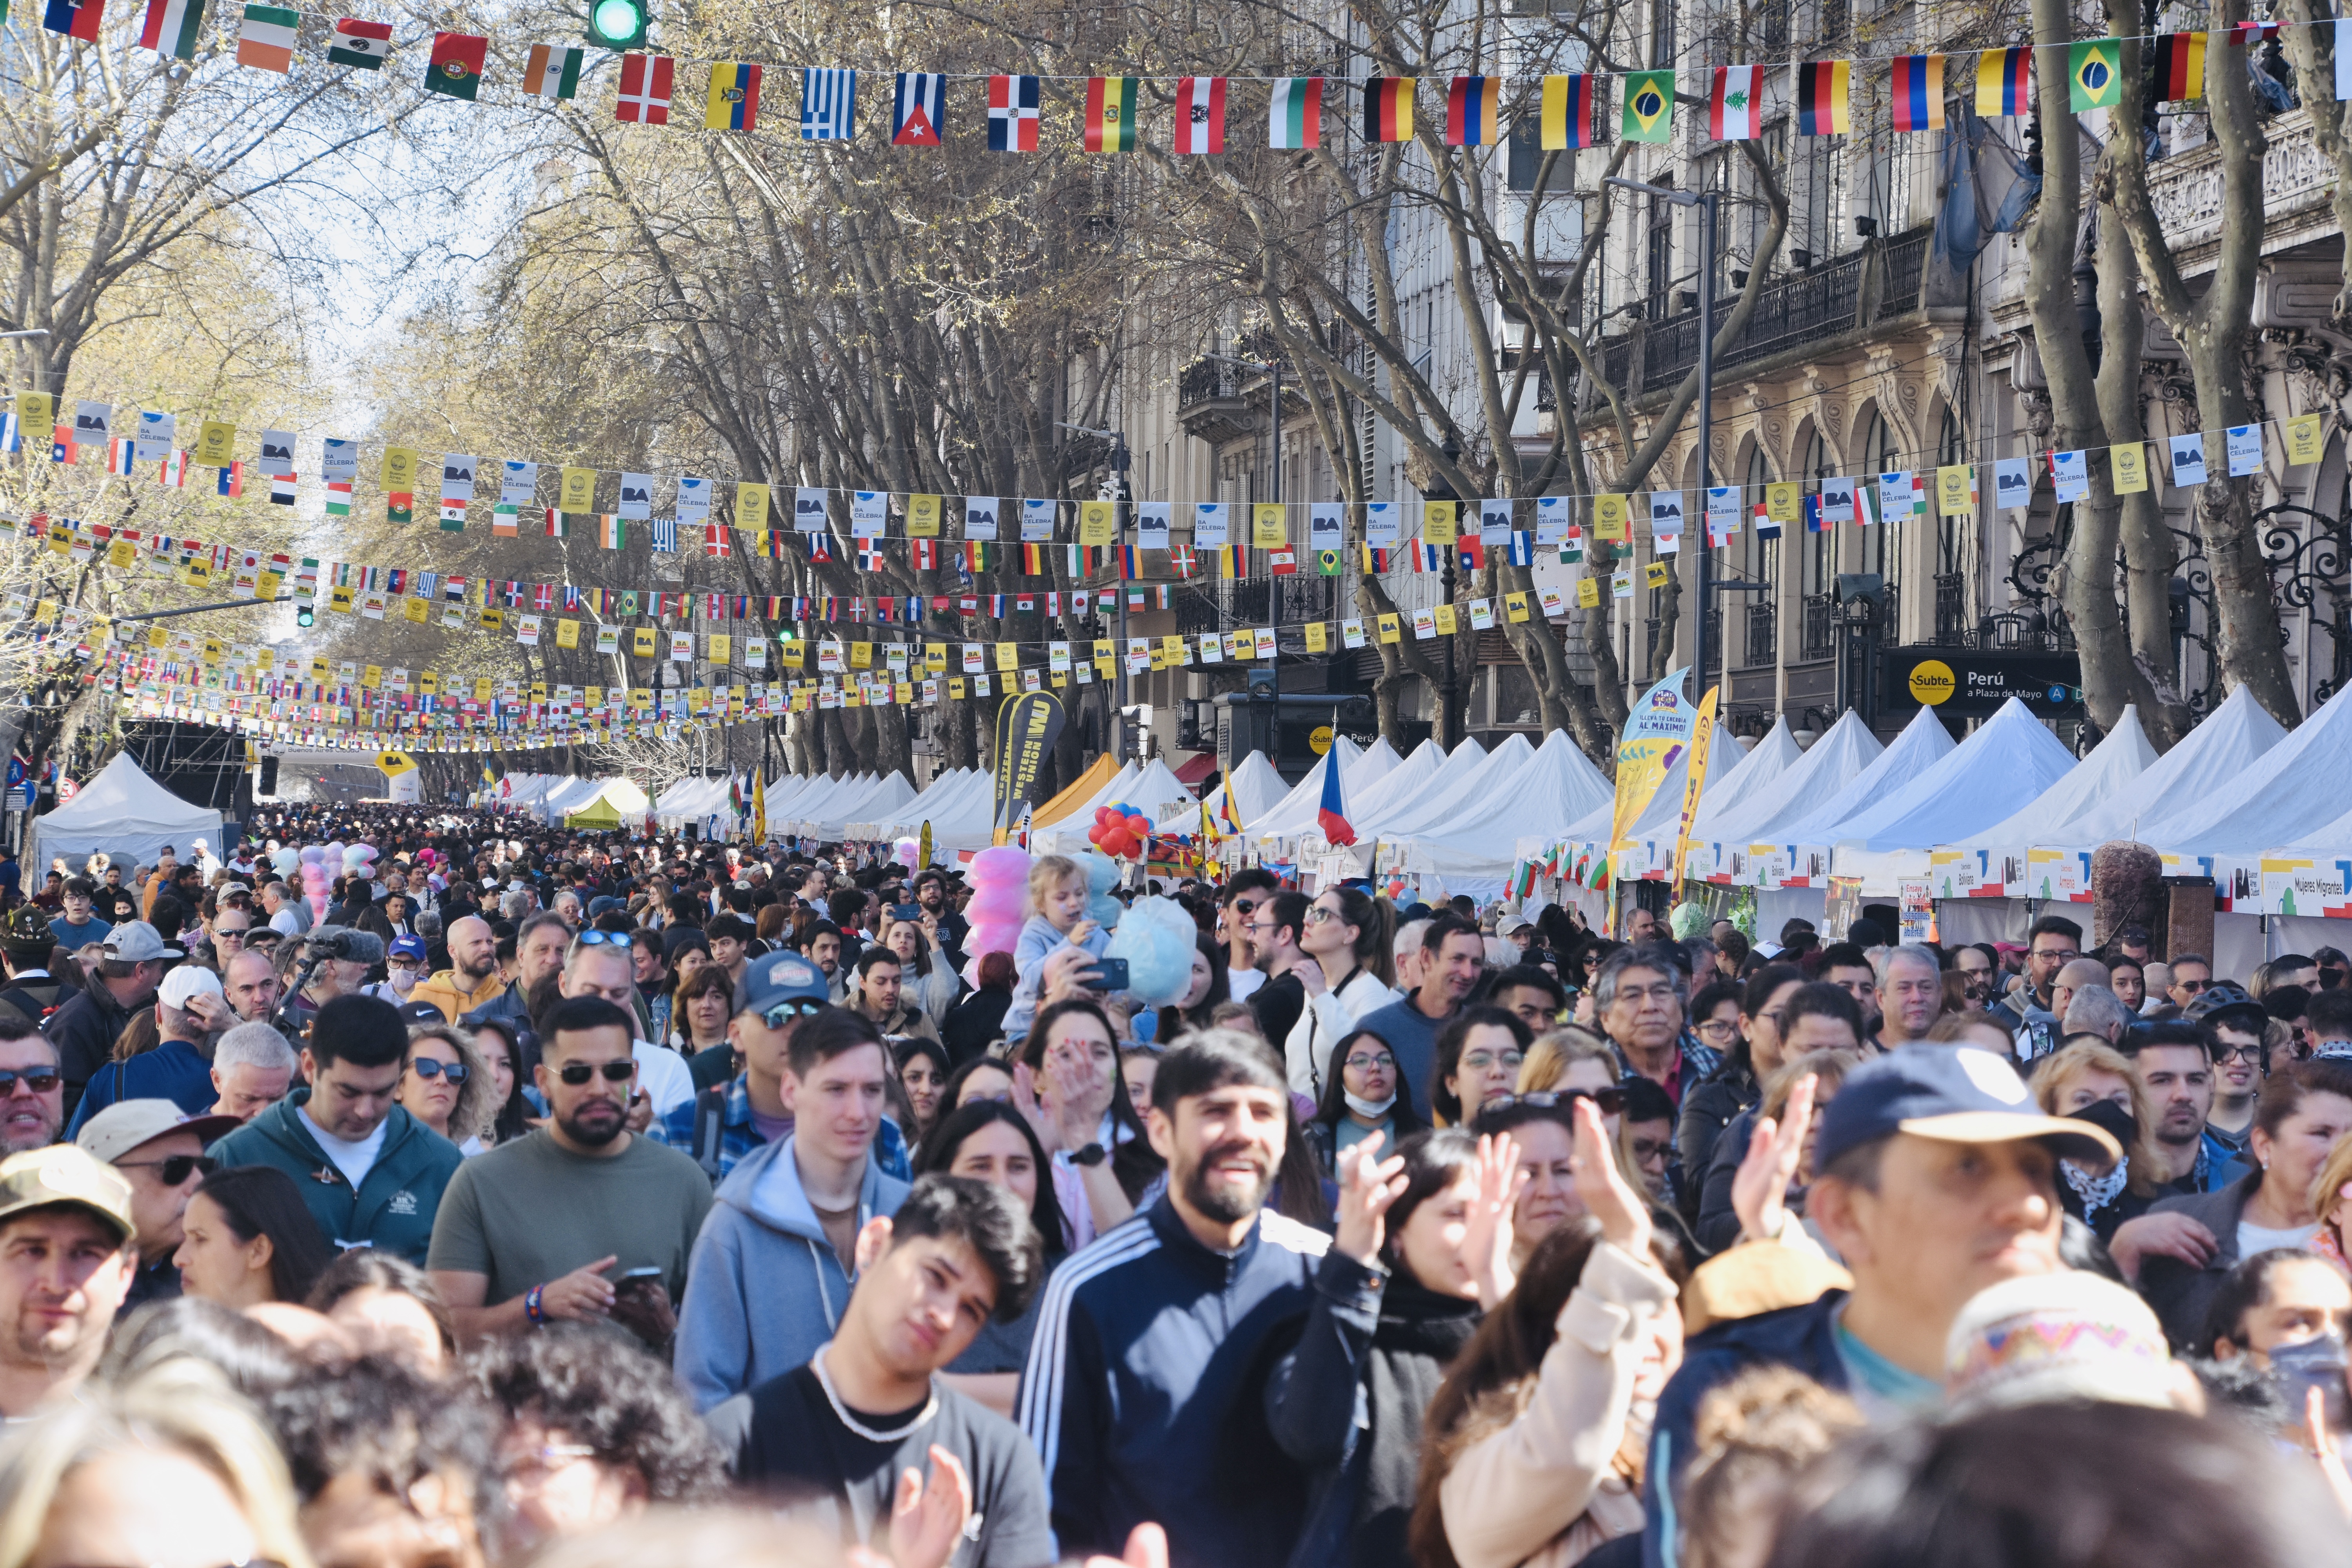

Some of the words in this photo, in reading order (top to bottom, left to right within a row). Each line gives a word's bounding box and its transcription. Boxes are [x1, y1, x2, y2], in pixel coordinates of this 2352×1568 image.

[77, 415, 105, 430] BA
[263, 445, 291, 459] BA
[2174, 450, 2202, 466] BA
[444, 466, 472, 481] BA
[1999, 474, 2027, 489] BA
[622, 487, 649, 502] BA
[1825, 492, 1852, 506] BA
[797, 500, 823, 513] BA
[1654, 504, 1681, 519] BA
[968, 510, 995, 524] BA
[1141, 517, 1167, 530] BA
[1313, 517, 1339, 531] BA
[1483, 512, 1509, 526] BA
[1916, 675, 1949, 685] Subte
[1969, 672, 2004, 685] Perú
[2017, 690, 2042, 699] Mayo
[2053, 688, 2062, 699] A
[1652, 721, 1686, 732] MÁXIMO!
[1352, 733, 1373, 742] Perú
[385, 756, 403, 765] BA
[1026, 742, 1042, 782] UNION
[1013, 741, 1033, 799] WESTERN
[1772, 866, 1784, 876] Boliviana
[1959, 874, 1973, 886] Boliviana
[2060, 875, 2075, 889] Armenia
[2250, 887, 2259, 896] Ciudad
[2295, 878, 2315, 895] Mujeres
[2316, 878, 2342, 897] Migrantes
